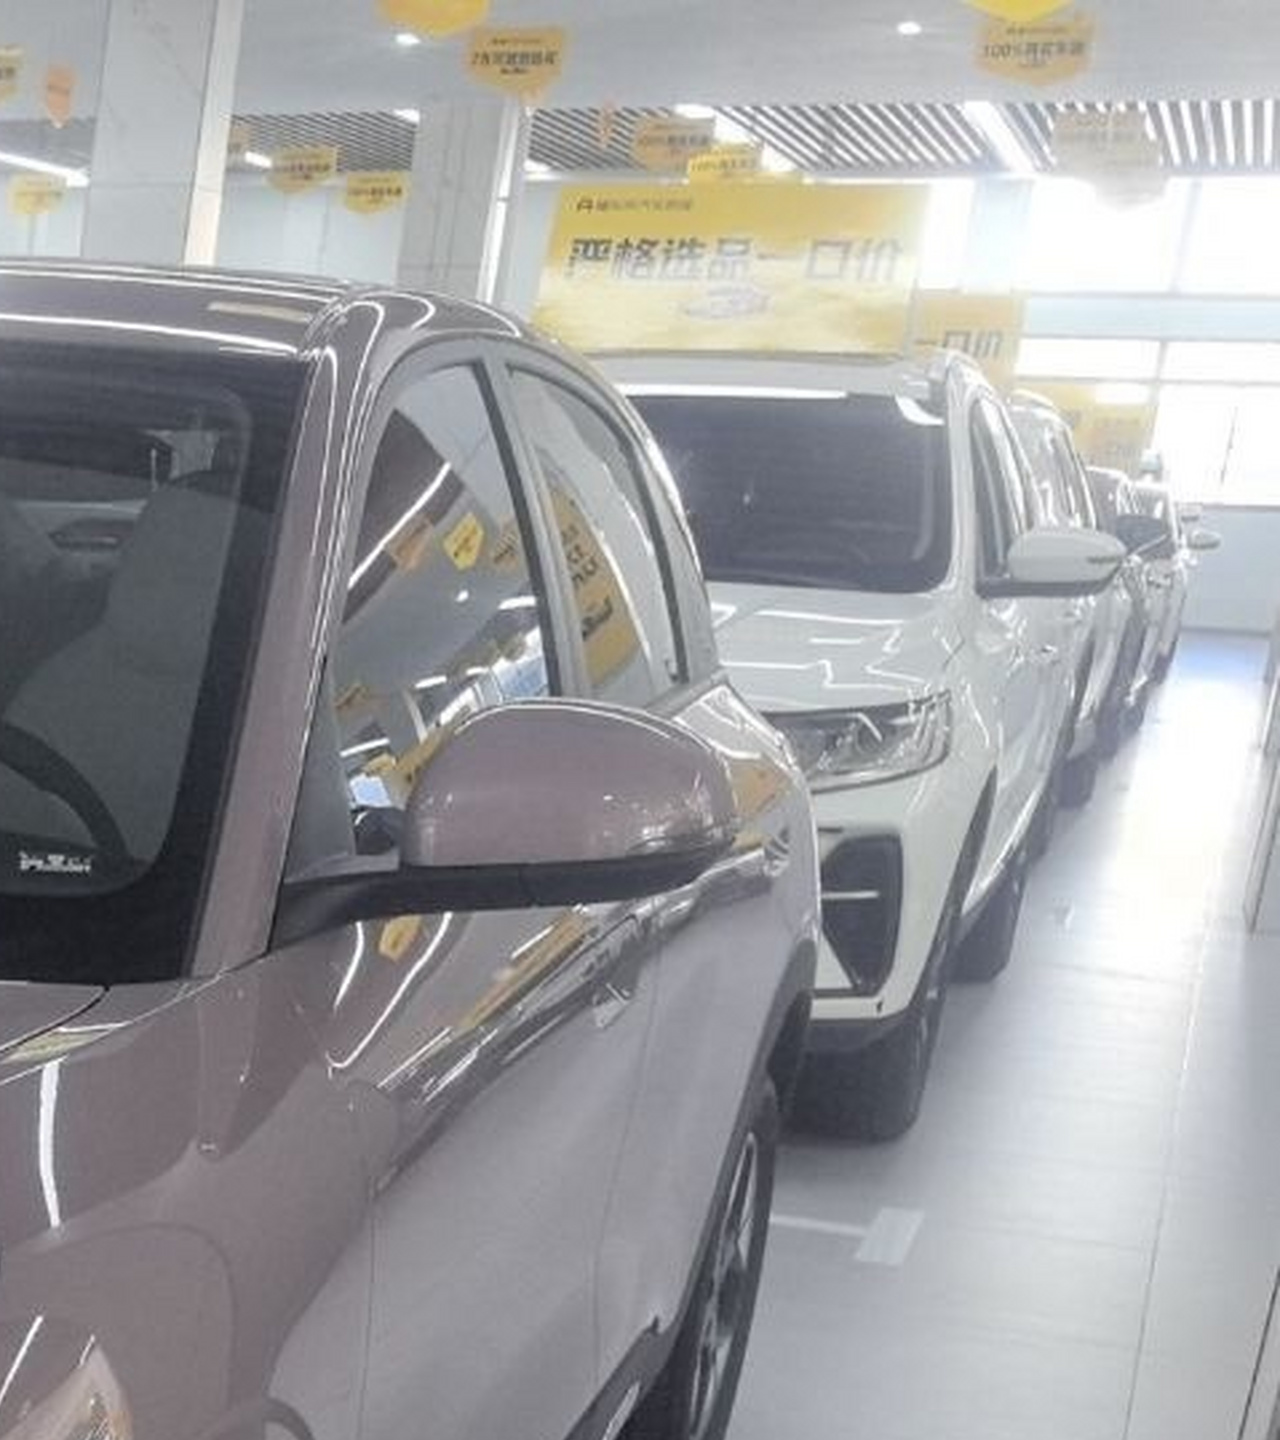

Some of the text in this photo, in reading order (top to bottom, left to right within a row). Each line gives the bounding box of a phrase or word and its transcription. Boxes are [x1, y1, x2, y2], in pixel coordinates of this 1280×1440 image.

[563, 236, 904, 281] 严格选品一口价
